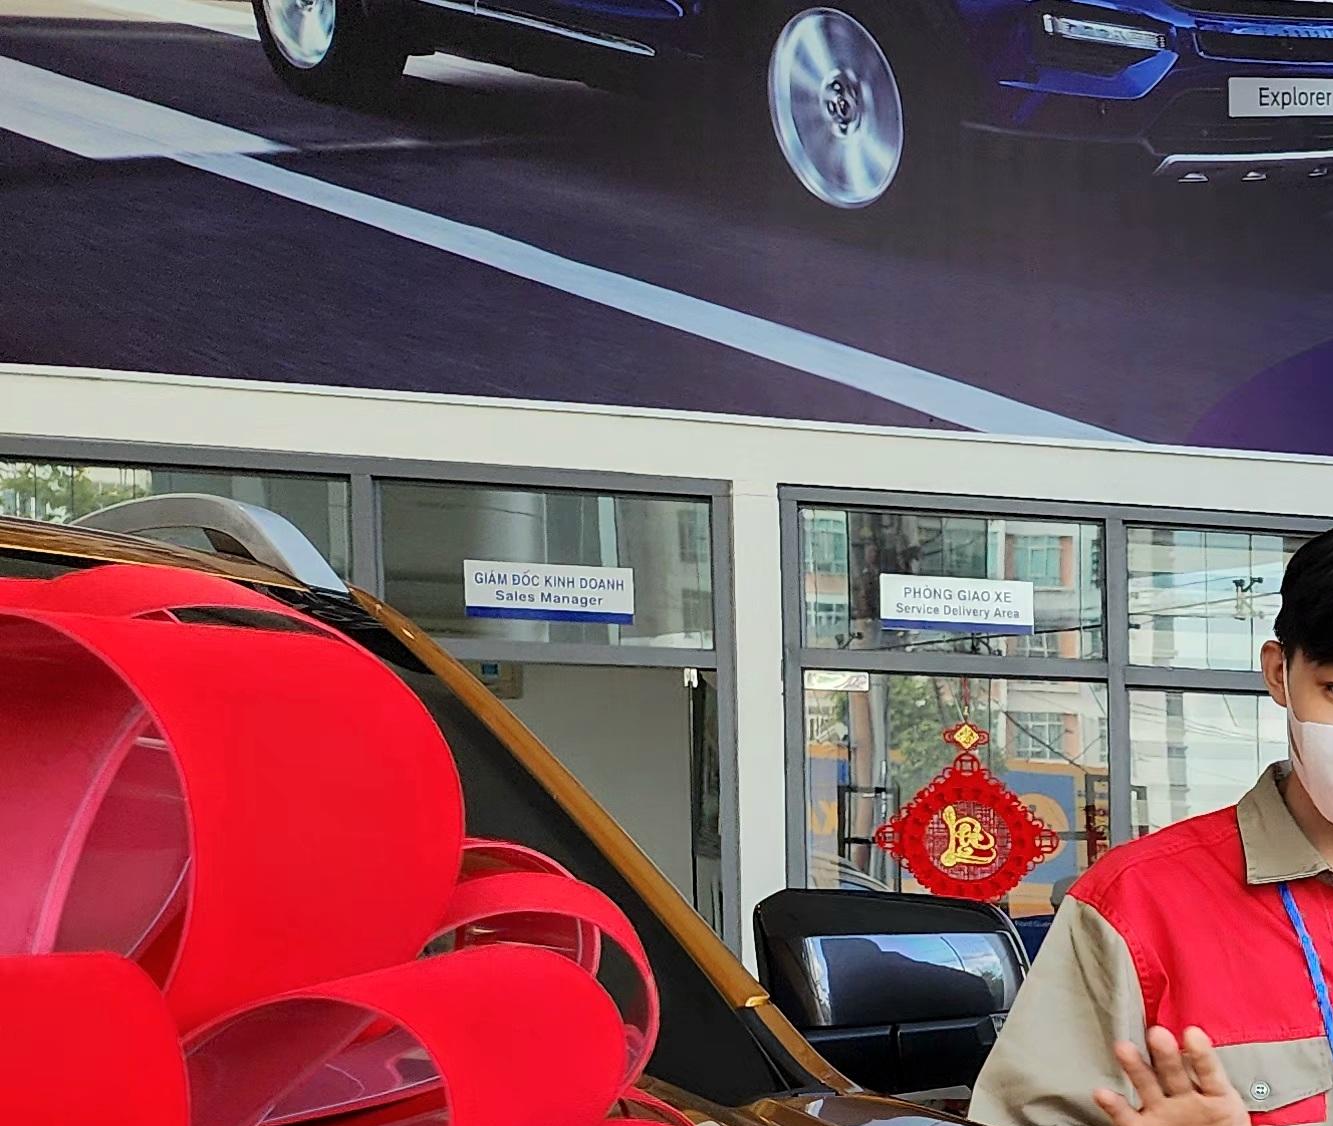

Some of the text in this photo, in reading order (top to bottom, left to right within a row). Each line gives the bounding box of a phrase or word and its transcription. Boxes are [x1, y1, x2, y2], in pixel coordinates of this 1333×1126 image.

[1258, 86, 1333, 110] Explorer
[474, 569, 624, 591] GIÁM ĐỐC KINH DOANH
[495, 590, 604, 608] Sales Manager
[957, 590, 990, 602] GIAO
[994, 591, 1012, 603] XE
[896, 603, 1020, 620] Service Delivery Area
